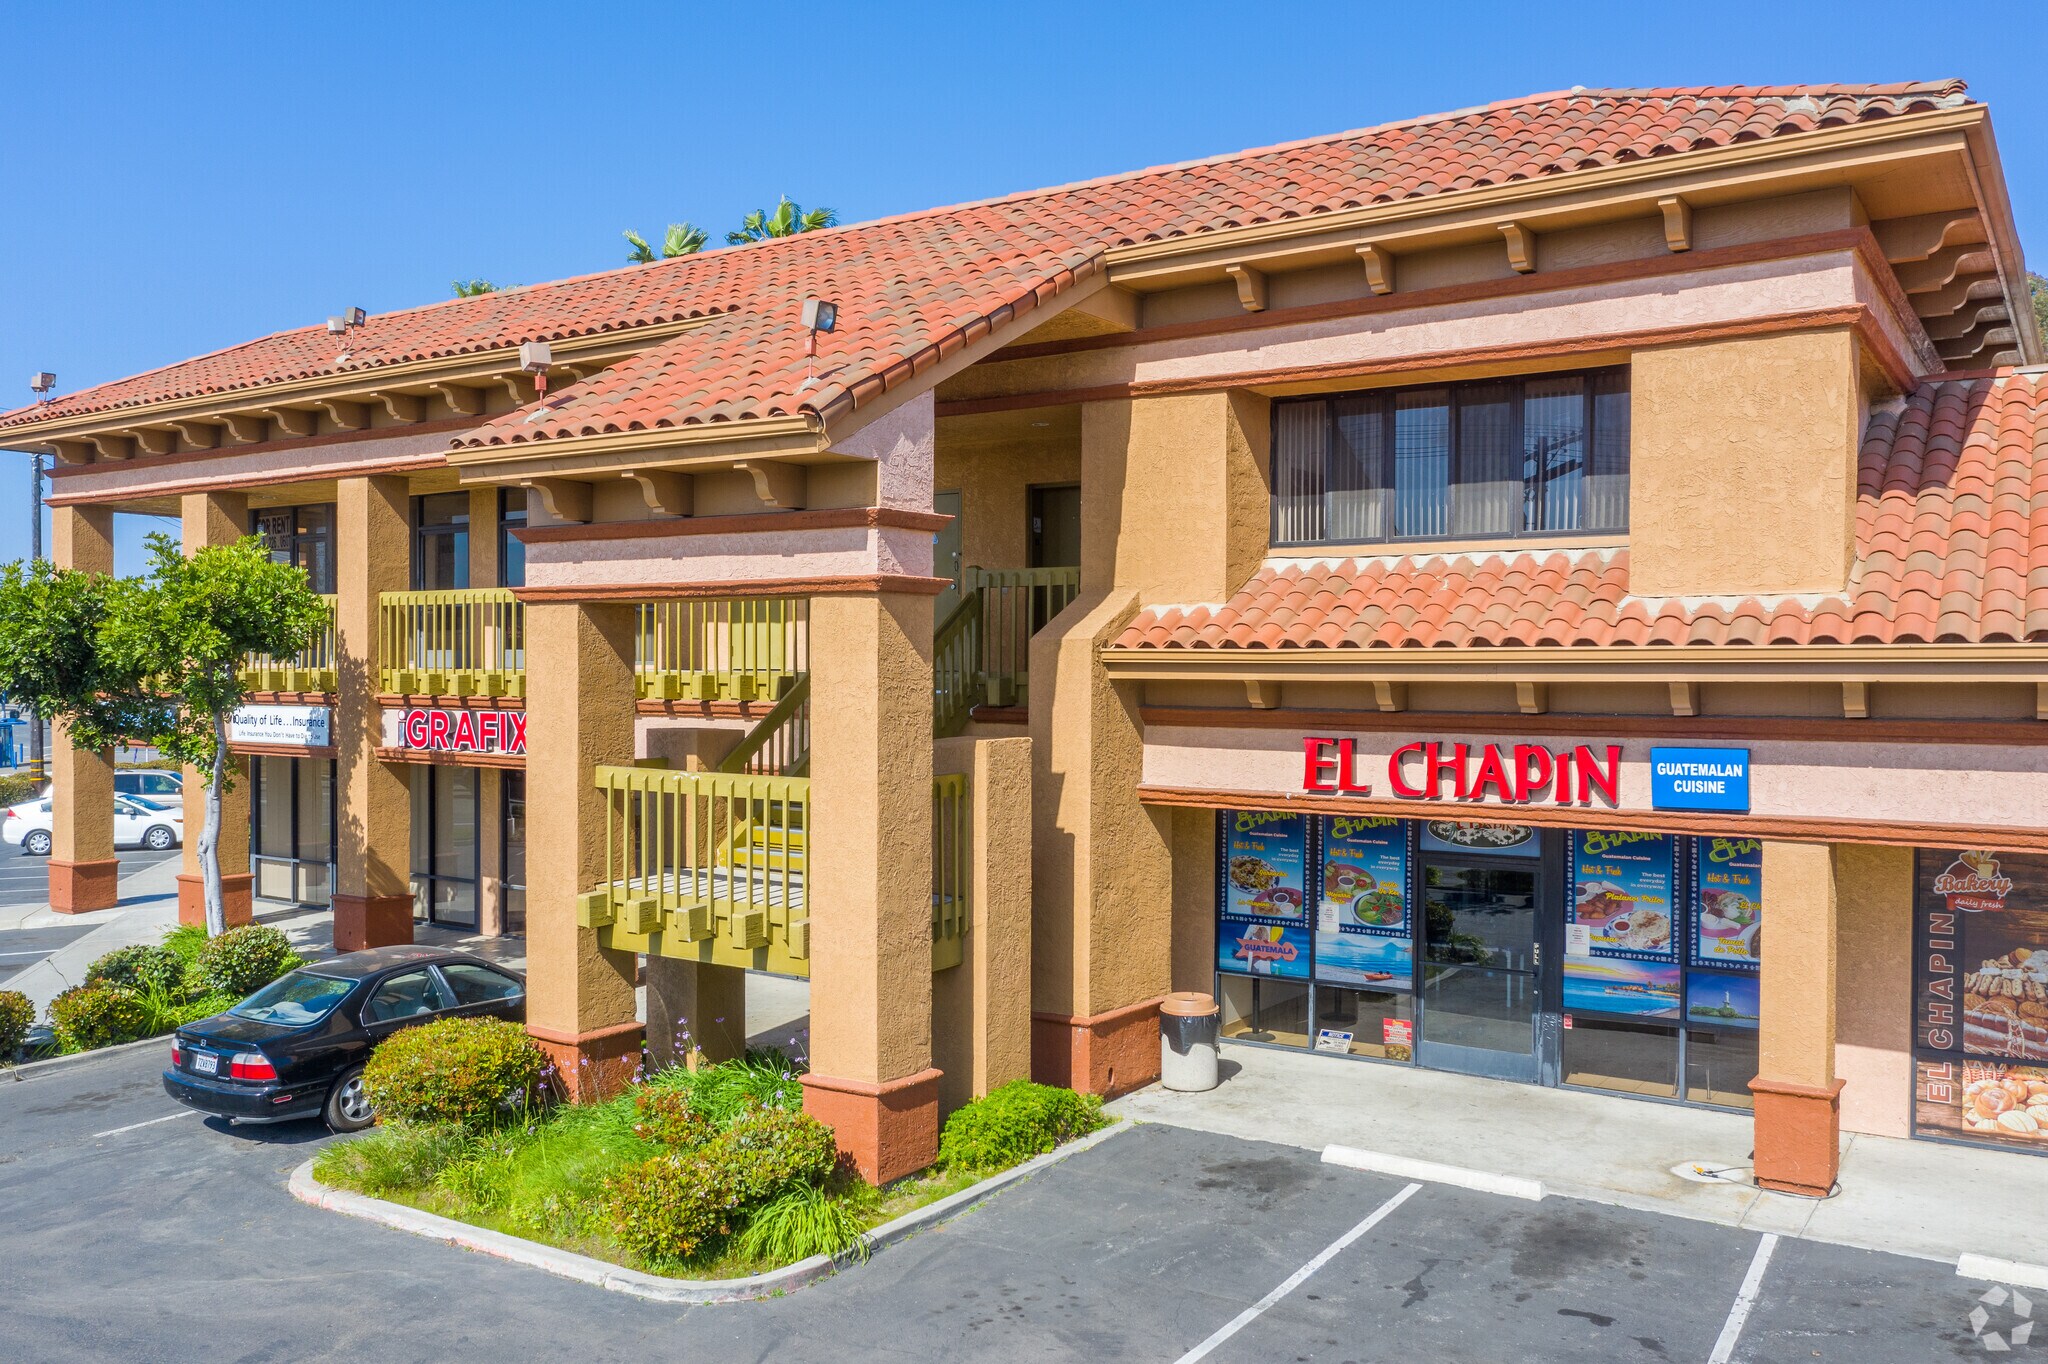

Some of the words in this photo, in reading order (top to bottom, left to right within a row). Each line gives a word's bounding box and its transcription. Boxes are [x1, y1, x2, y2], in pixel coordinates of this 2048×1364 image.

[272, 516, 290, 535] RENT
[259, 715, 267, 725] of
[273, 731, 285, 739] Don't
[1303, 737, 1369, 793] EL
[1388, 741, 1622, 807] CHAPIN
[1657, 762, 1743, 777] GUATEMALAN
[1674, 780, 1726, 793] CUISINE
[1933, 873, 2013, 897] Bakery
[1955, 898, 1978, 908] daily
[1980, 900, 2004, 909] fresh
[1244, 943, 1294, 955] GUATEMALA
[1928, 913, 1954, 1050] CHAPIN
